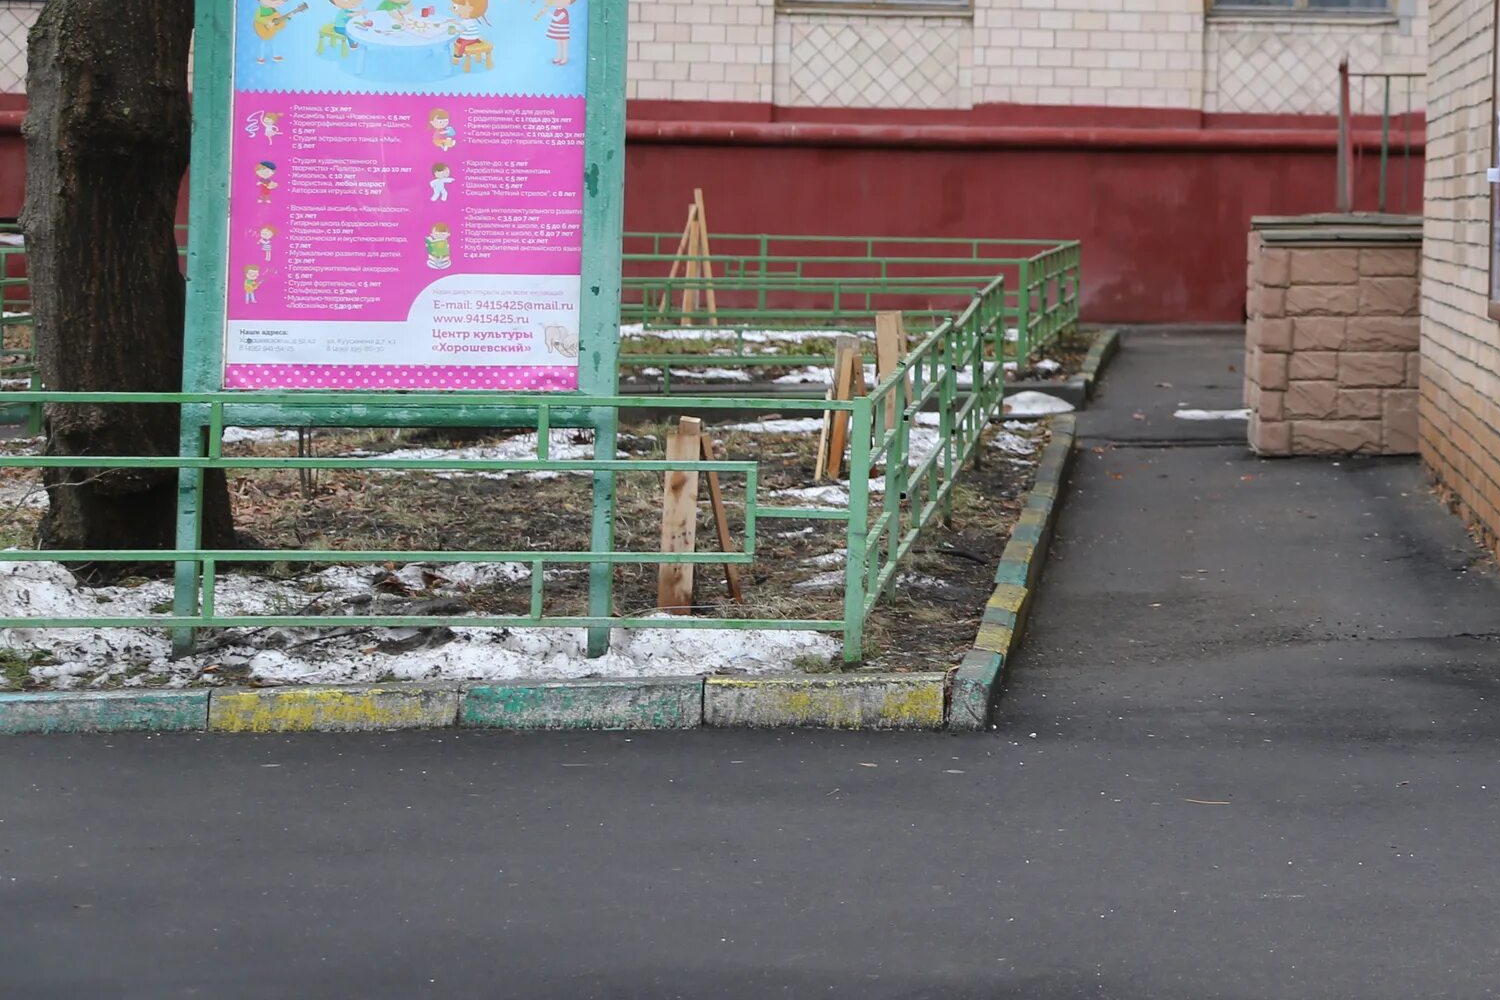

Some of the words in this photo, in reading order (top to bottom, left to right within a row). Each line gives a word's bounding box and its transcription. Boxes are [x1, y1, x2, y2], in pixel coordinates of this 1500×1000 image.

[433, 299, 472, 310] E-mail:
[475, 300, 574, 312] 9415425@mail.ru
[433, 313, 530, 324] www.9415425.ru
[432, 328, 470, 341] Центр
[473, 330, 533, 341] культуры
[432, 342, 532, 354] «Хорошевский»
